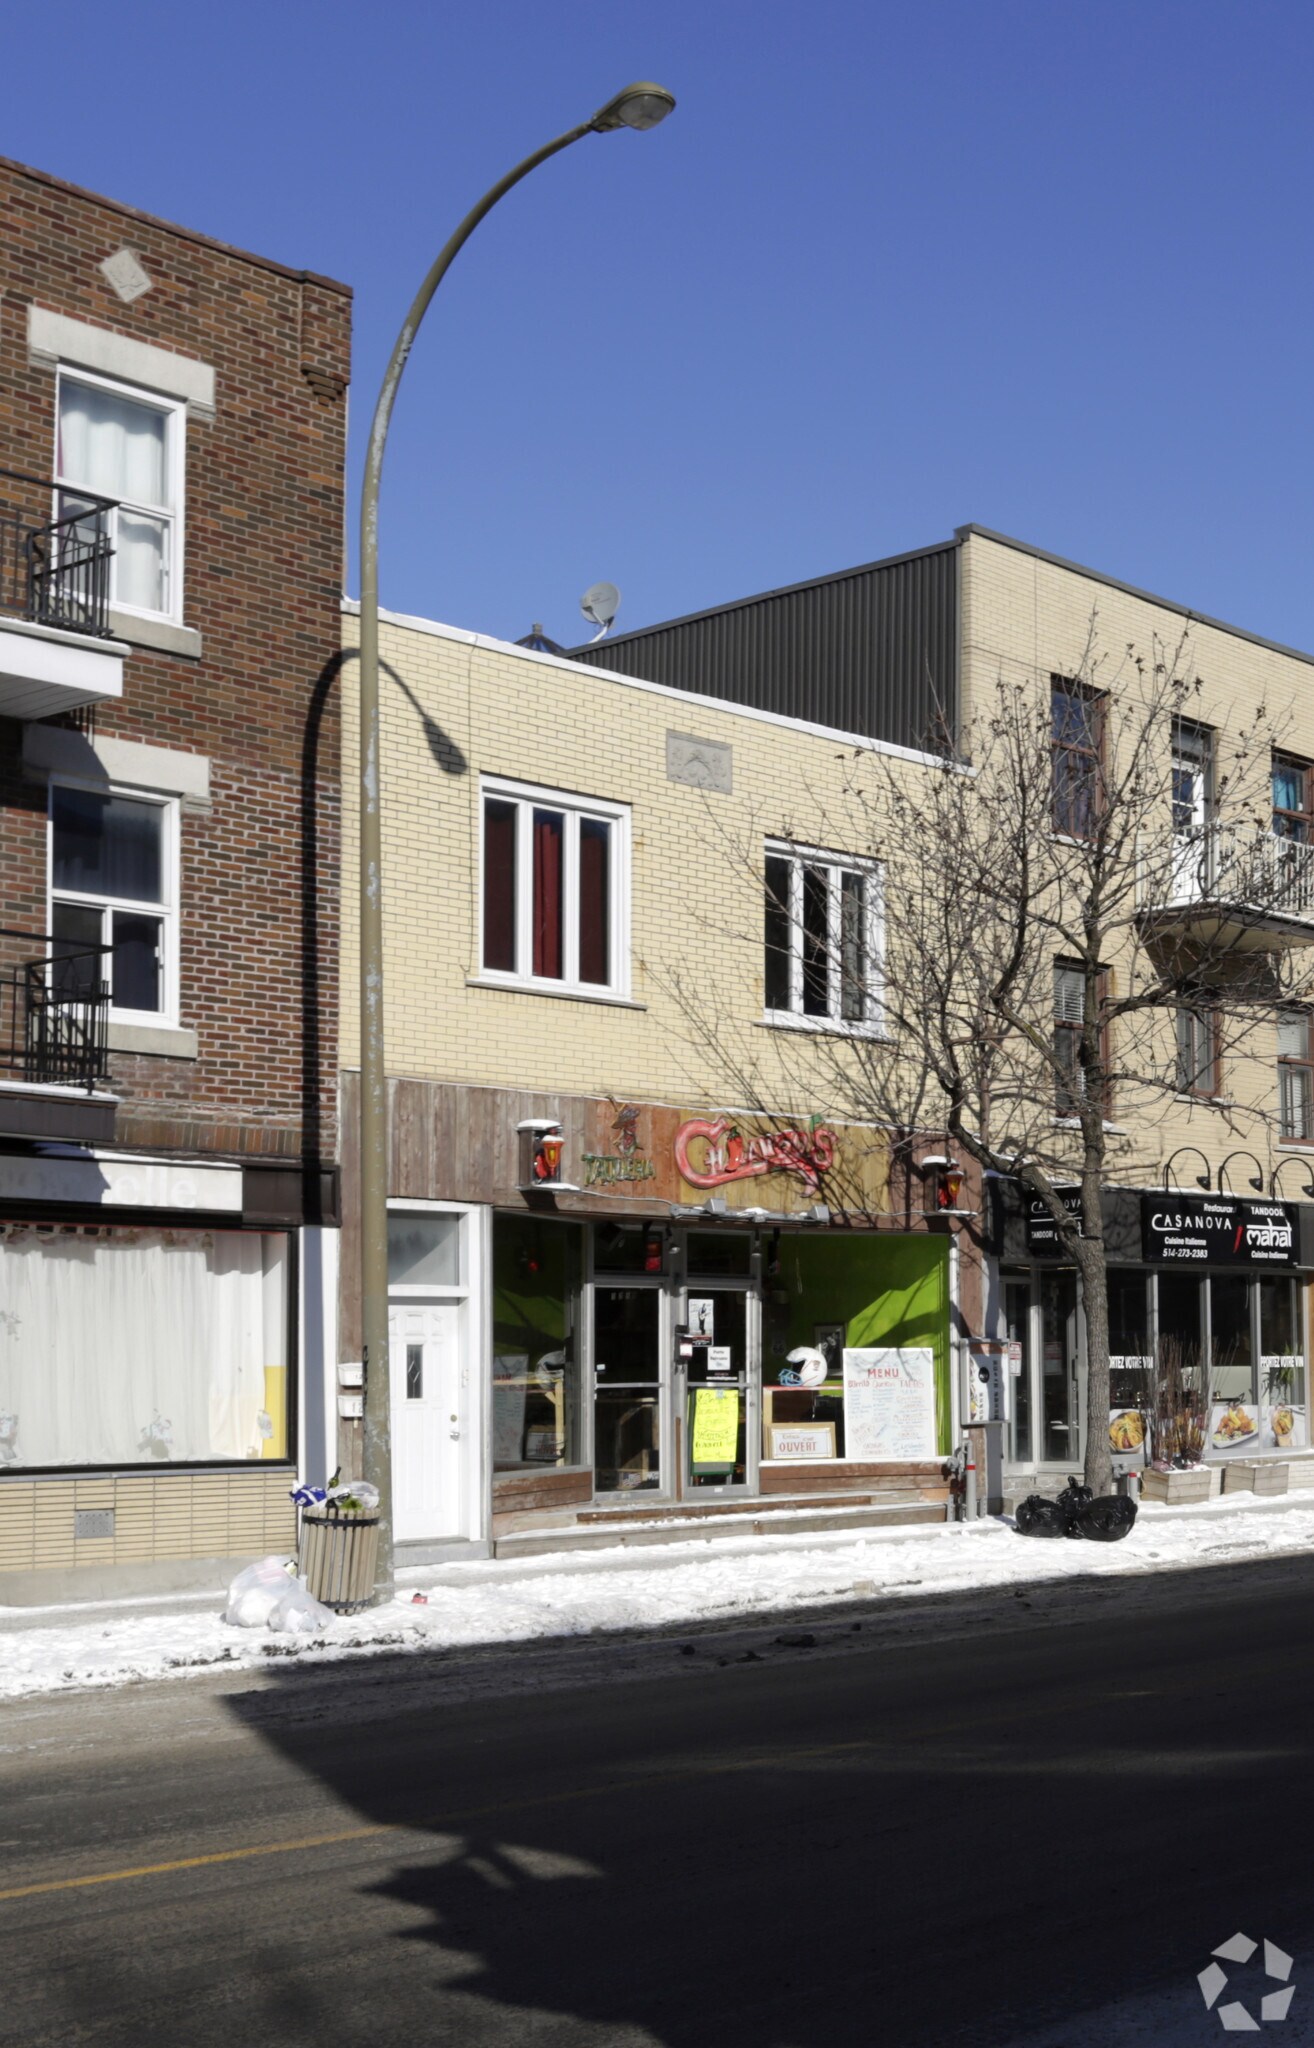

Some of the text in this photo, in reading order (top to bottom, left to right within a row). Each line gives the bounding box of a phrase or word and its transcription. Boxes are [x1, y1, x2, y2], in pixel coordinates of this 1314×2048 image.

[1031, 1199, 1082, 1214] CAOVA
[1250, 1206, 1285, 1217] TANDOOR
[1151, 1213, 1233, 1232] CASANOVA
[1164, 1236, 1207, 1247] Cuisine Italienne
[1251, 1250, 1289, 1260] Cuisine Indienne
[1260, 1356, 1280, 1367] PPORTEZ
[867, 1368, 900, 1378] MENU
[779, 1441, 817, 1452] OUVERT
